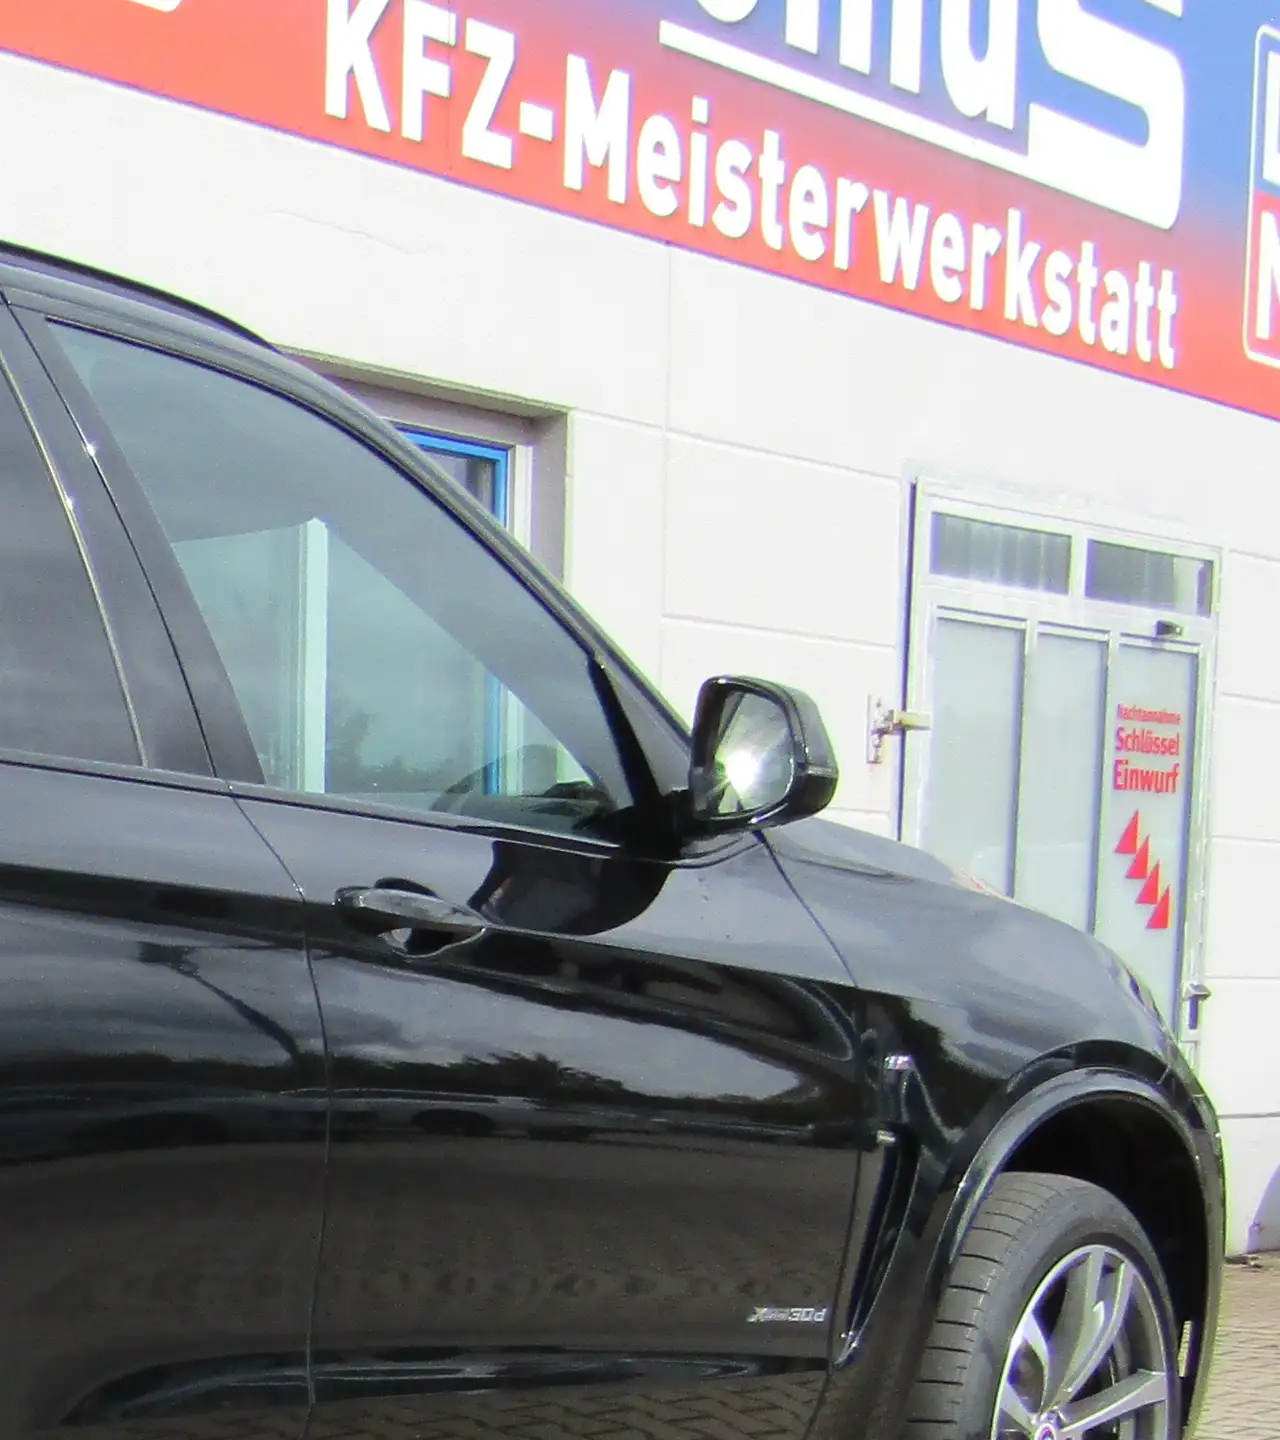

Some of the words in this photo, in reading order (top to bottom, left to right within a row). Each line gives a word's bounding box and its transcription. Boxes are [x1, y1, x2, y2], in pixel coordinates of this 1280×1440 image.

[324, 0, 1178, 369] KFZ-Meisterwerkstatt
[1115, 727, 1180, 756] Schlüssel
[1113, 759, 1180, 793] Einwurf
